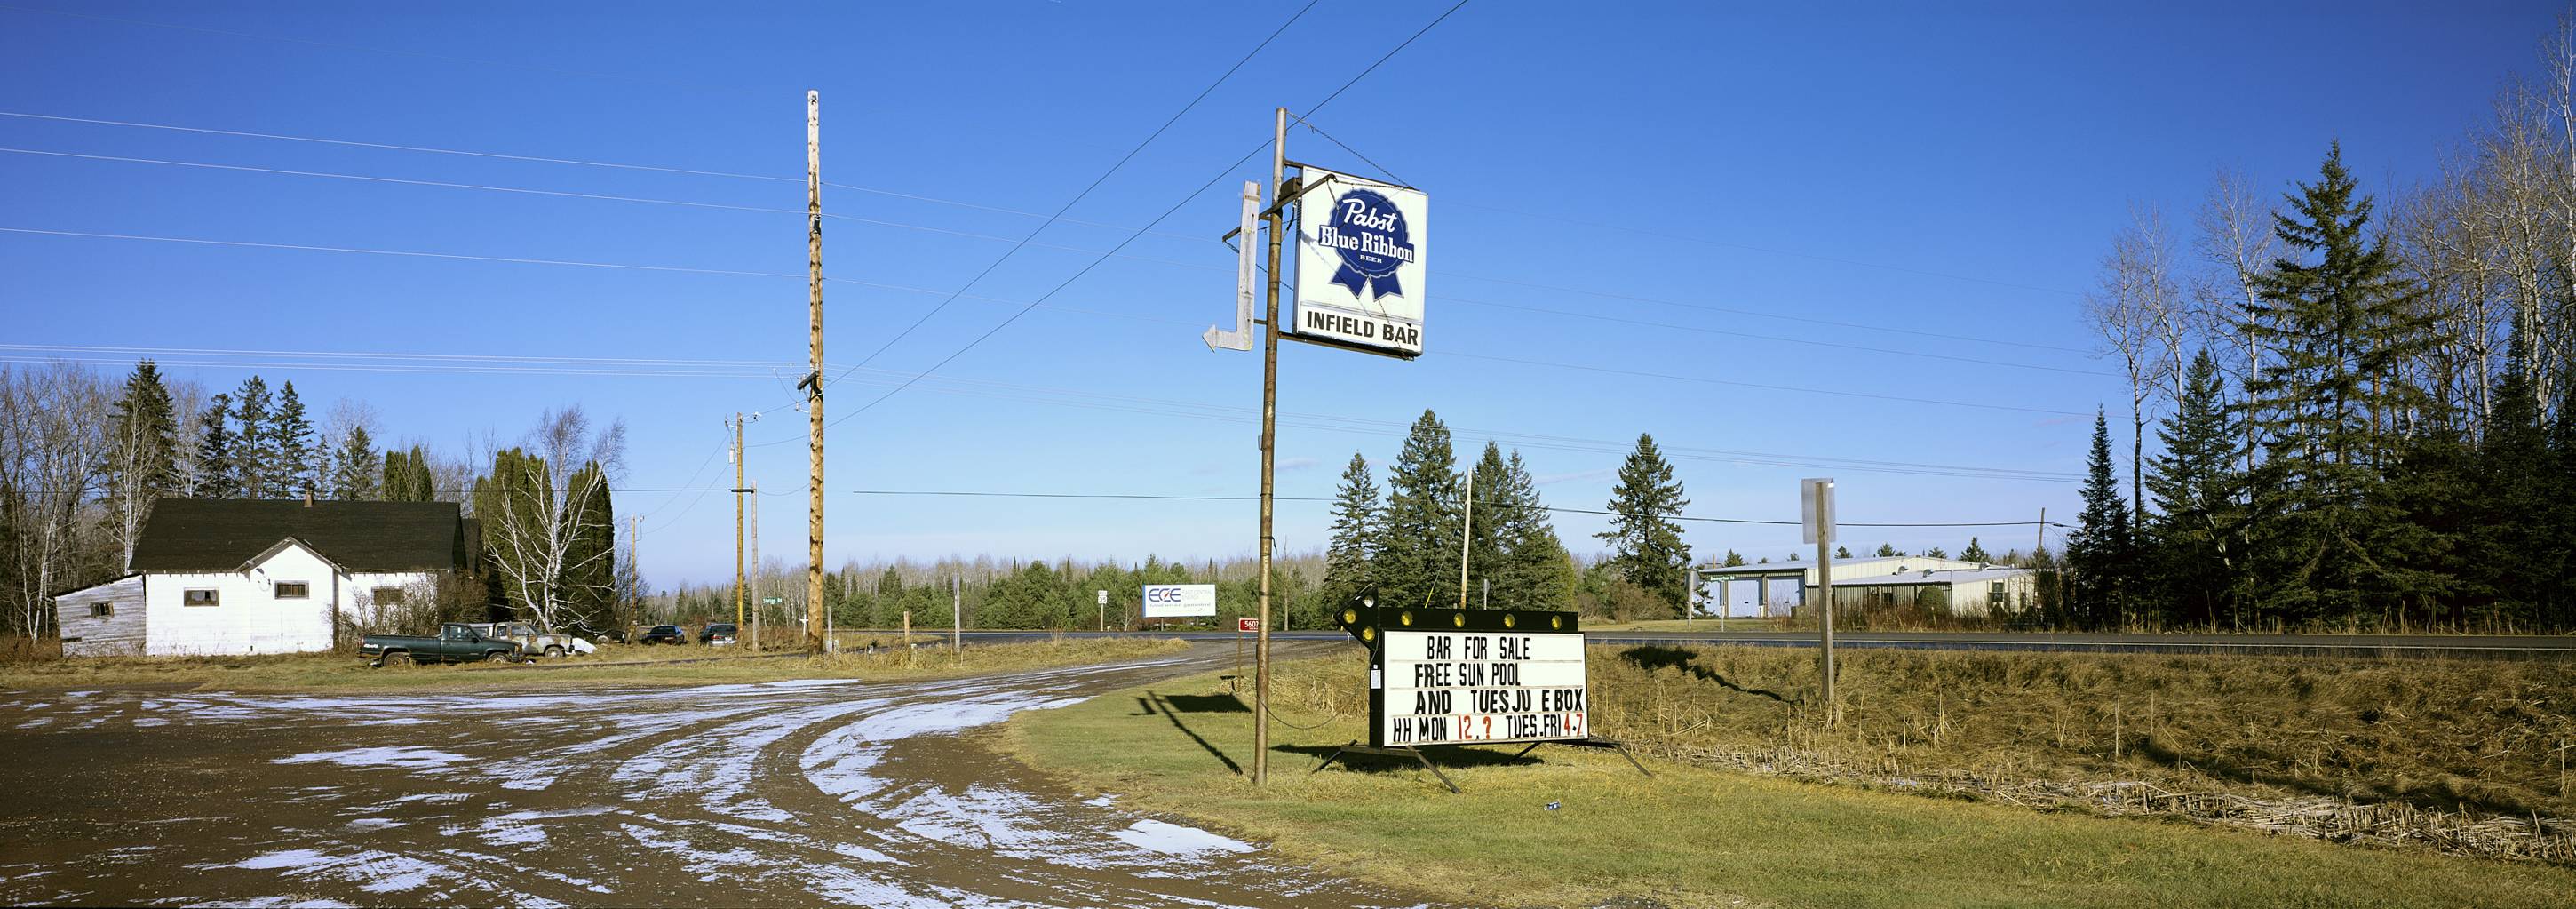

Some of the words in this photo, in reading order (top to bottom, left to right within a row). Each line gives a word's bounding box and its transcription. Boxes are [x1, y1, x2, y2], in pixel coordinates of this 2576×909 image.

[1342, 198, 1397, 233] Pabst
[1320, 225, 1359, 251] Blue
[1361, 232, 1414, 263] Ribbon
[1359, 254, 1383, 264] BEER
[1307, 310, 1375, 339] INFIELD
[1382, 323, 1419, 346] BAR
[1427, 635, 1451, 660] BAR
[1464, 636, 1488, 660] FOR
[1499, 636, 1530, 660] SALE
[1414, 662, 1451, 688] FREE
[1459, 662, 1484, 687] SUN
[1491, 662, 1521, 686] POOL
[1414, 690, 1451, 715] AND
[1393, 717, 1411, 743] HH
[1419, 716, 1447, 742] MON
